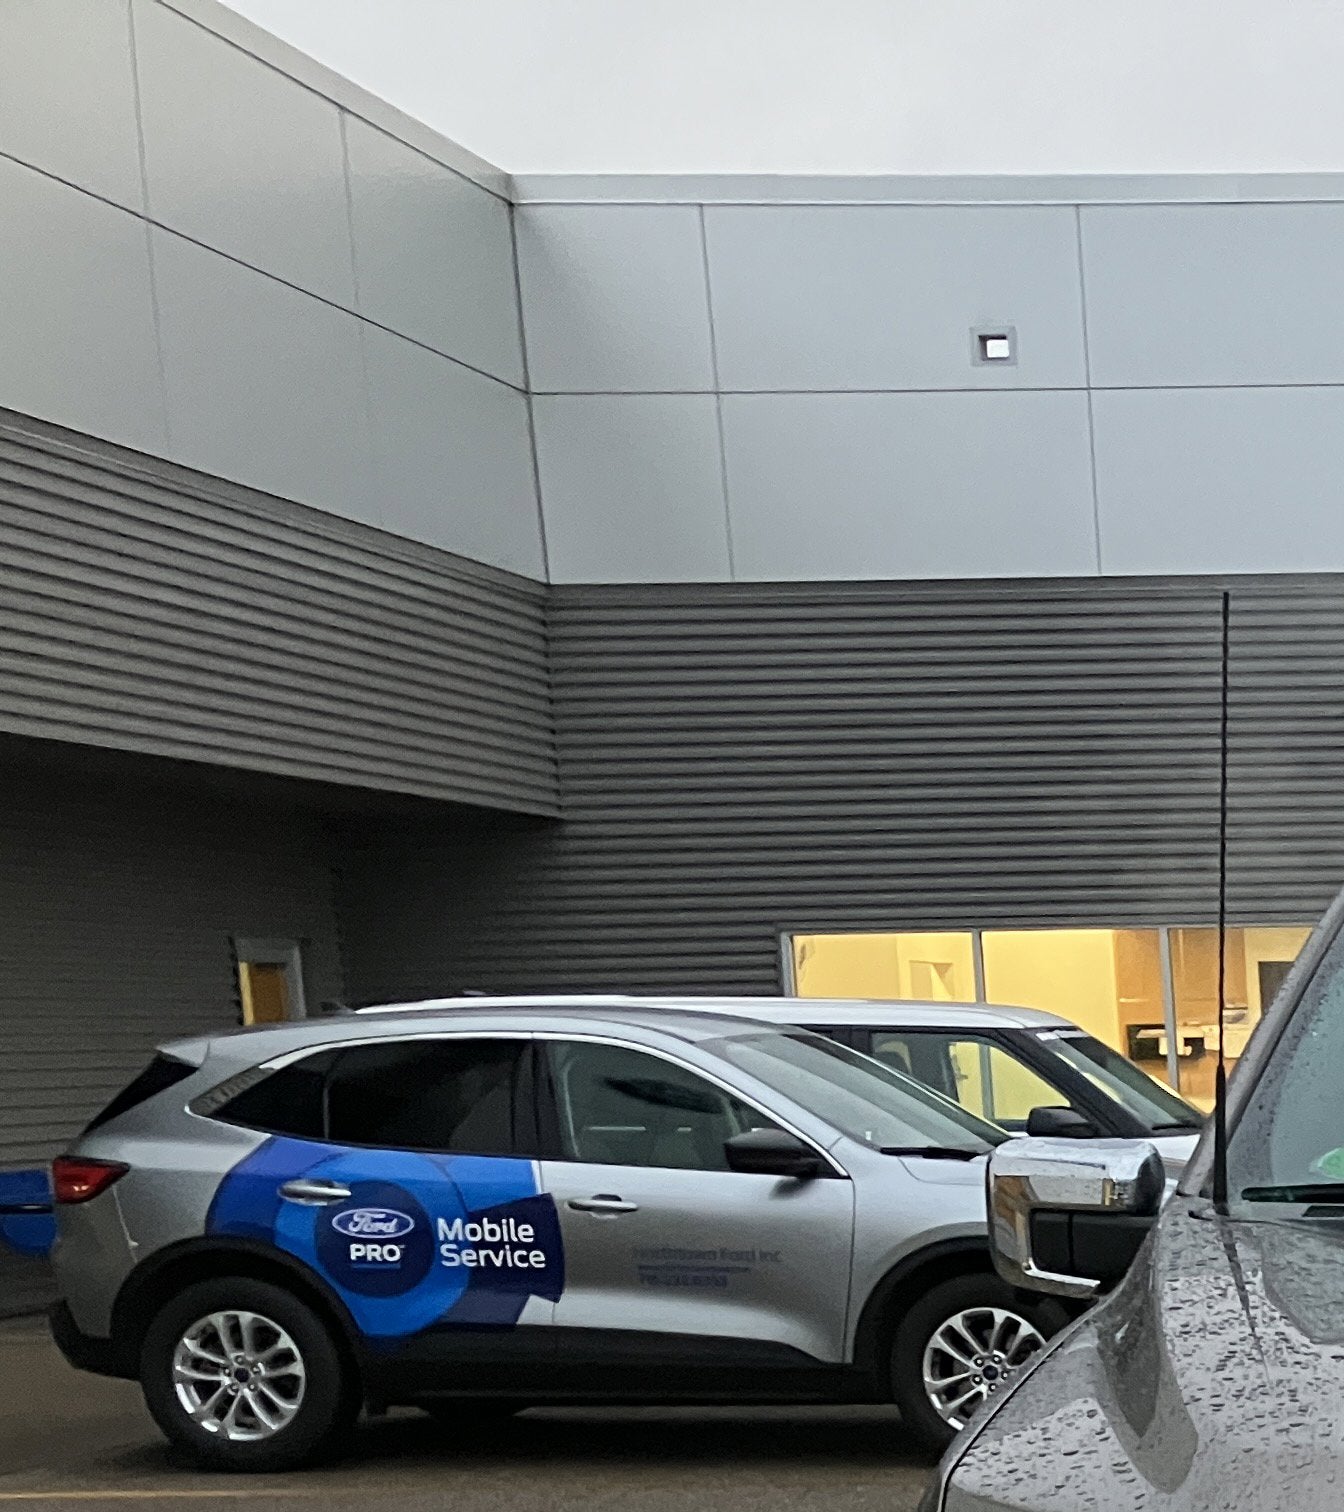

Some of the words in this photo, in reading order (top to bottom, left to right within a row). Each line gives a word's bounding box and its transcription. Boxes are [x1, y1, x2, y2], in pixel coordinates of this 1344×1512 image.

[348, 1210, 399, 1234] Ford
[437, 1217, 535, 1243] Mobile
[439, 1243, 546, 1269] Service
